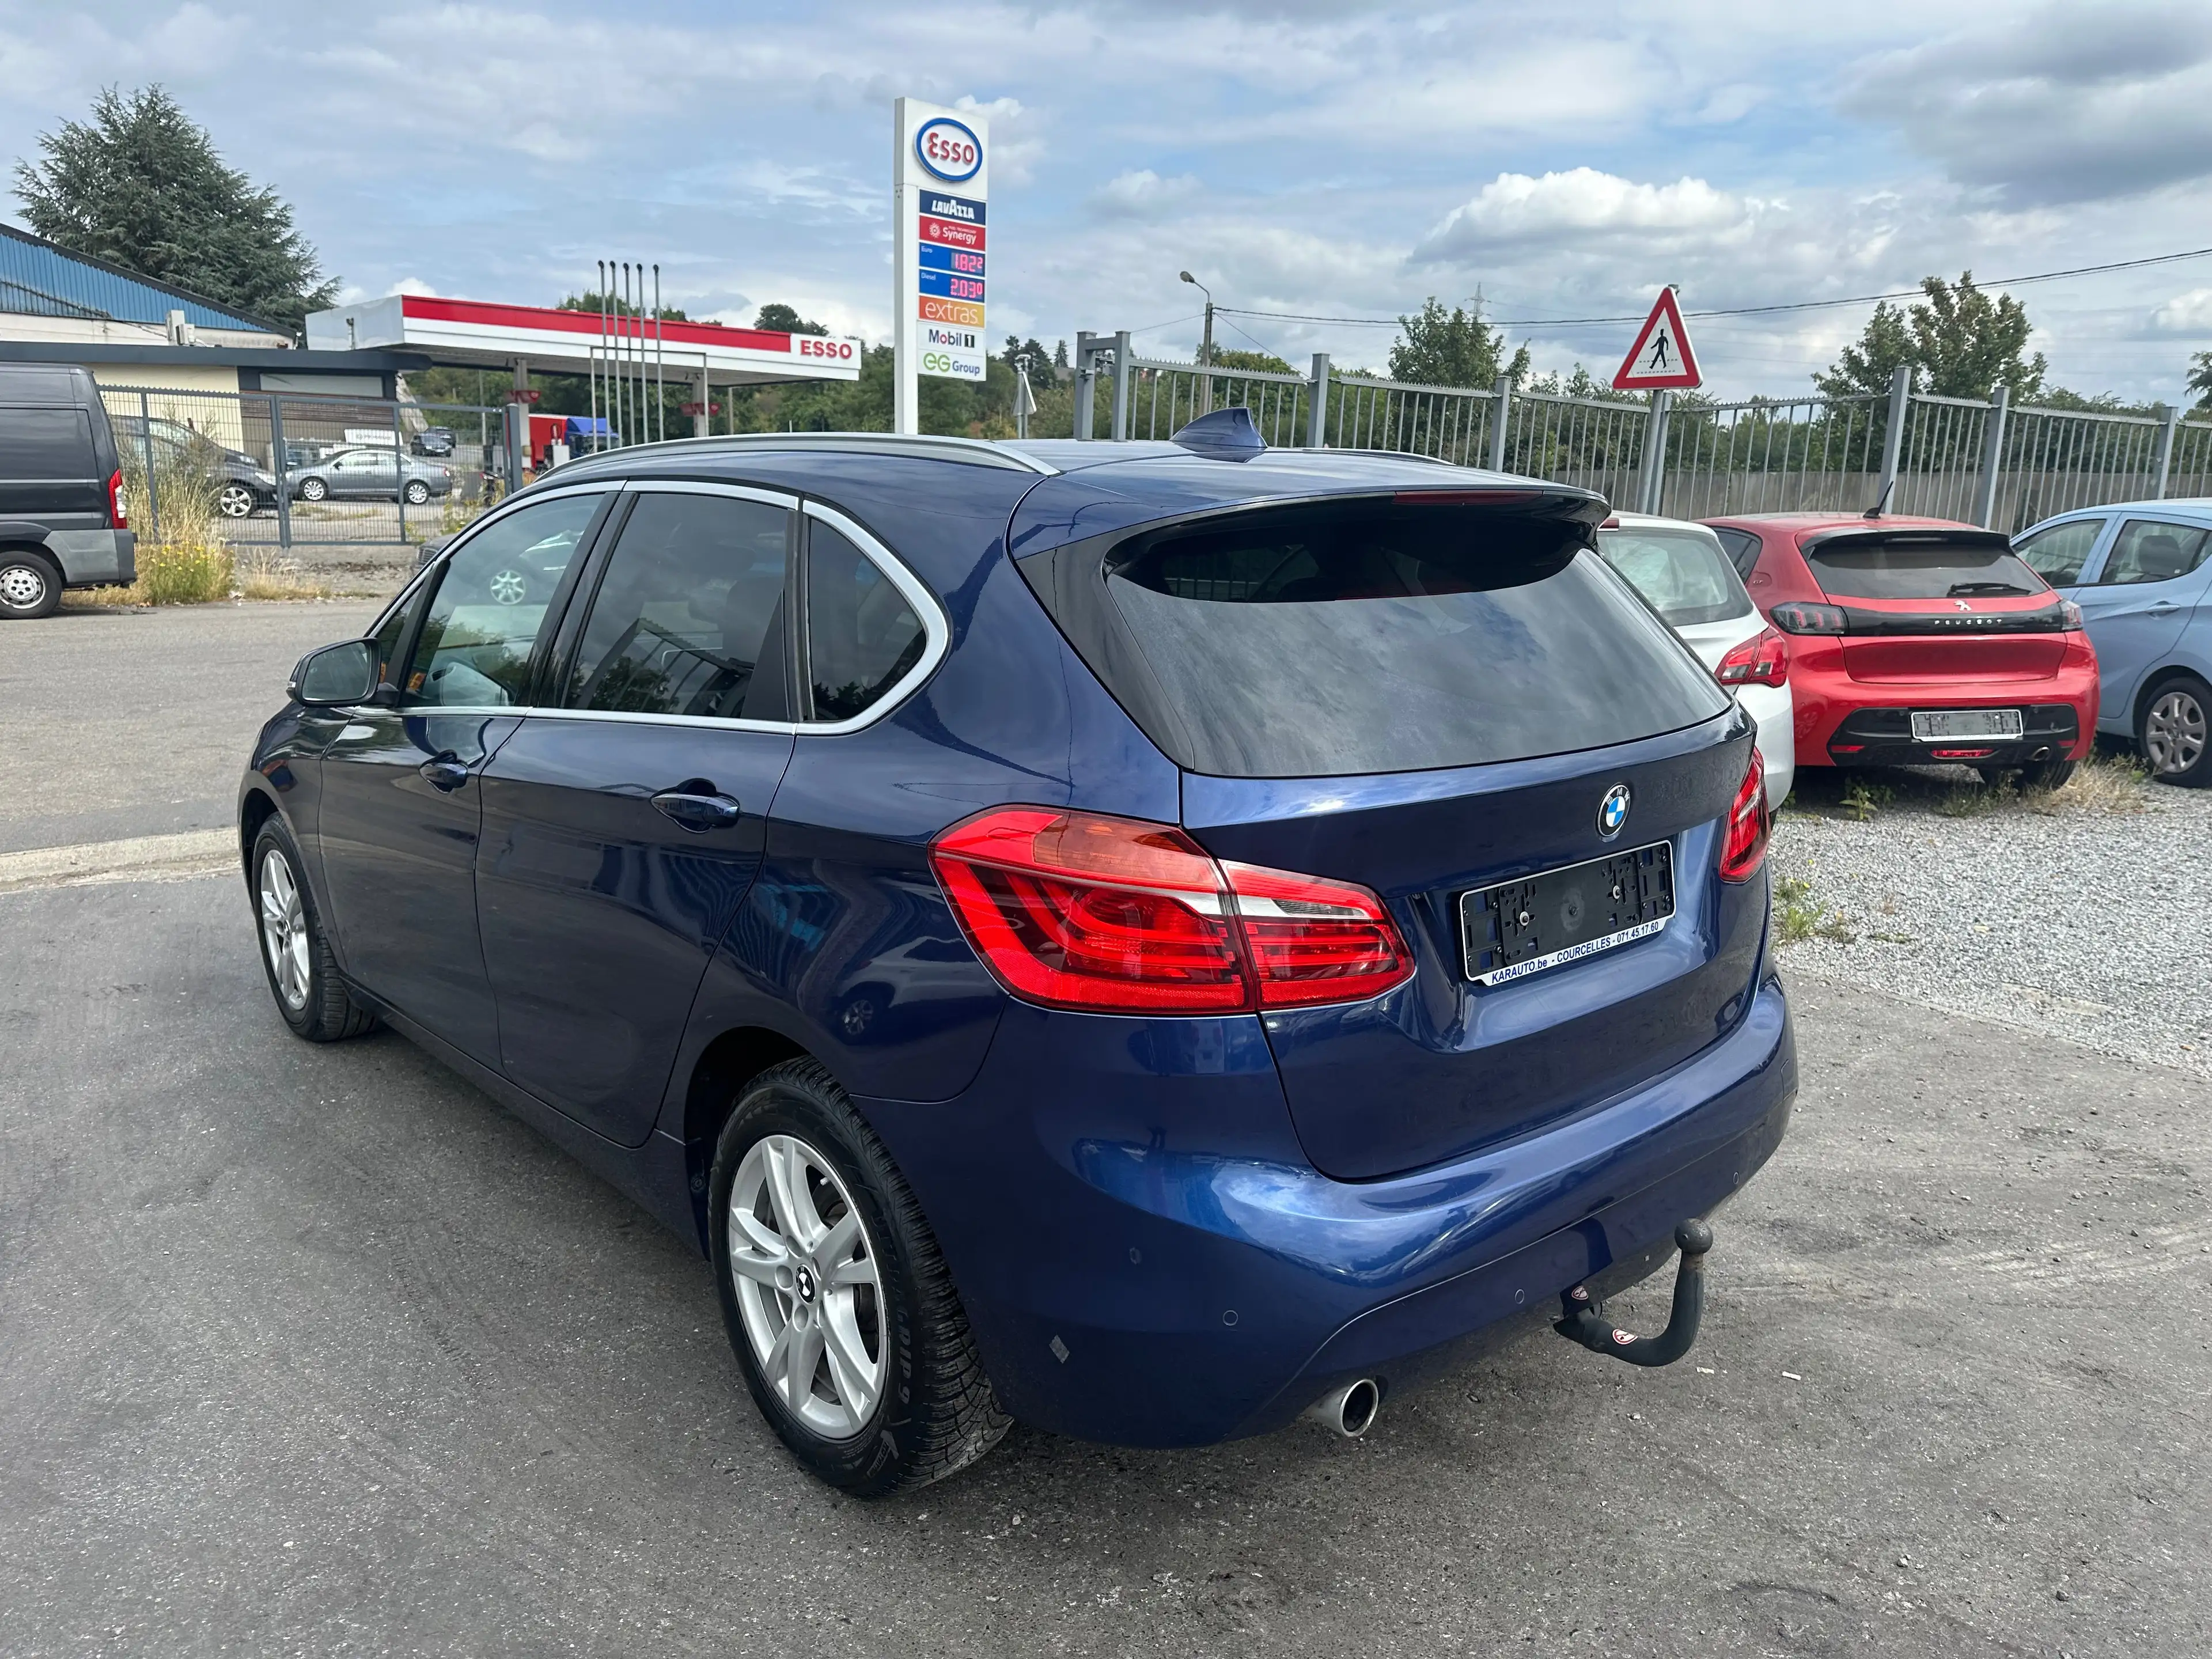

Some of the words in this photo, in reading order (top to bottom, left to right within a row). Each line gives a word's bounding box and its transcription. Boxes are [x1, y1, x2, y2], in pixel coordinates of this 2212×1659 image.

[931, 199, 975, 219] LAVAZZA
[942, 227, 977, 245] Synergy
[925, 301, 979, 324] extras
[929, 329, 961, 346] Mobil
[800, 340, 852, 359] ESSO
[952, 361, 980, 376] Group
[1606, 787, 1630, 806] BMW
[1492, 958, 1547, 984] KARAUTO.be
[1558, 937, 1611, 963] COURCELLES
[1617, 921, 1659, 943] 071.45.17.60
